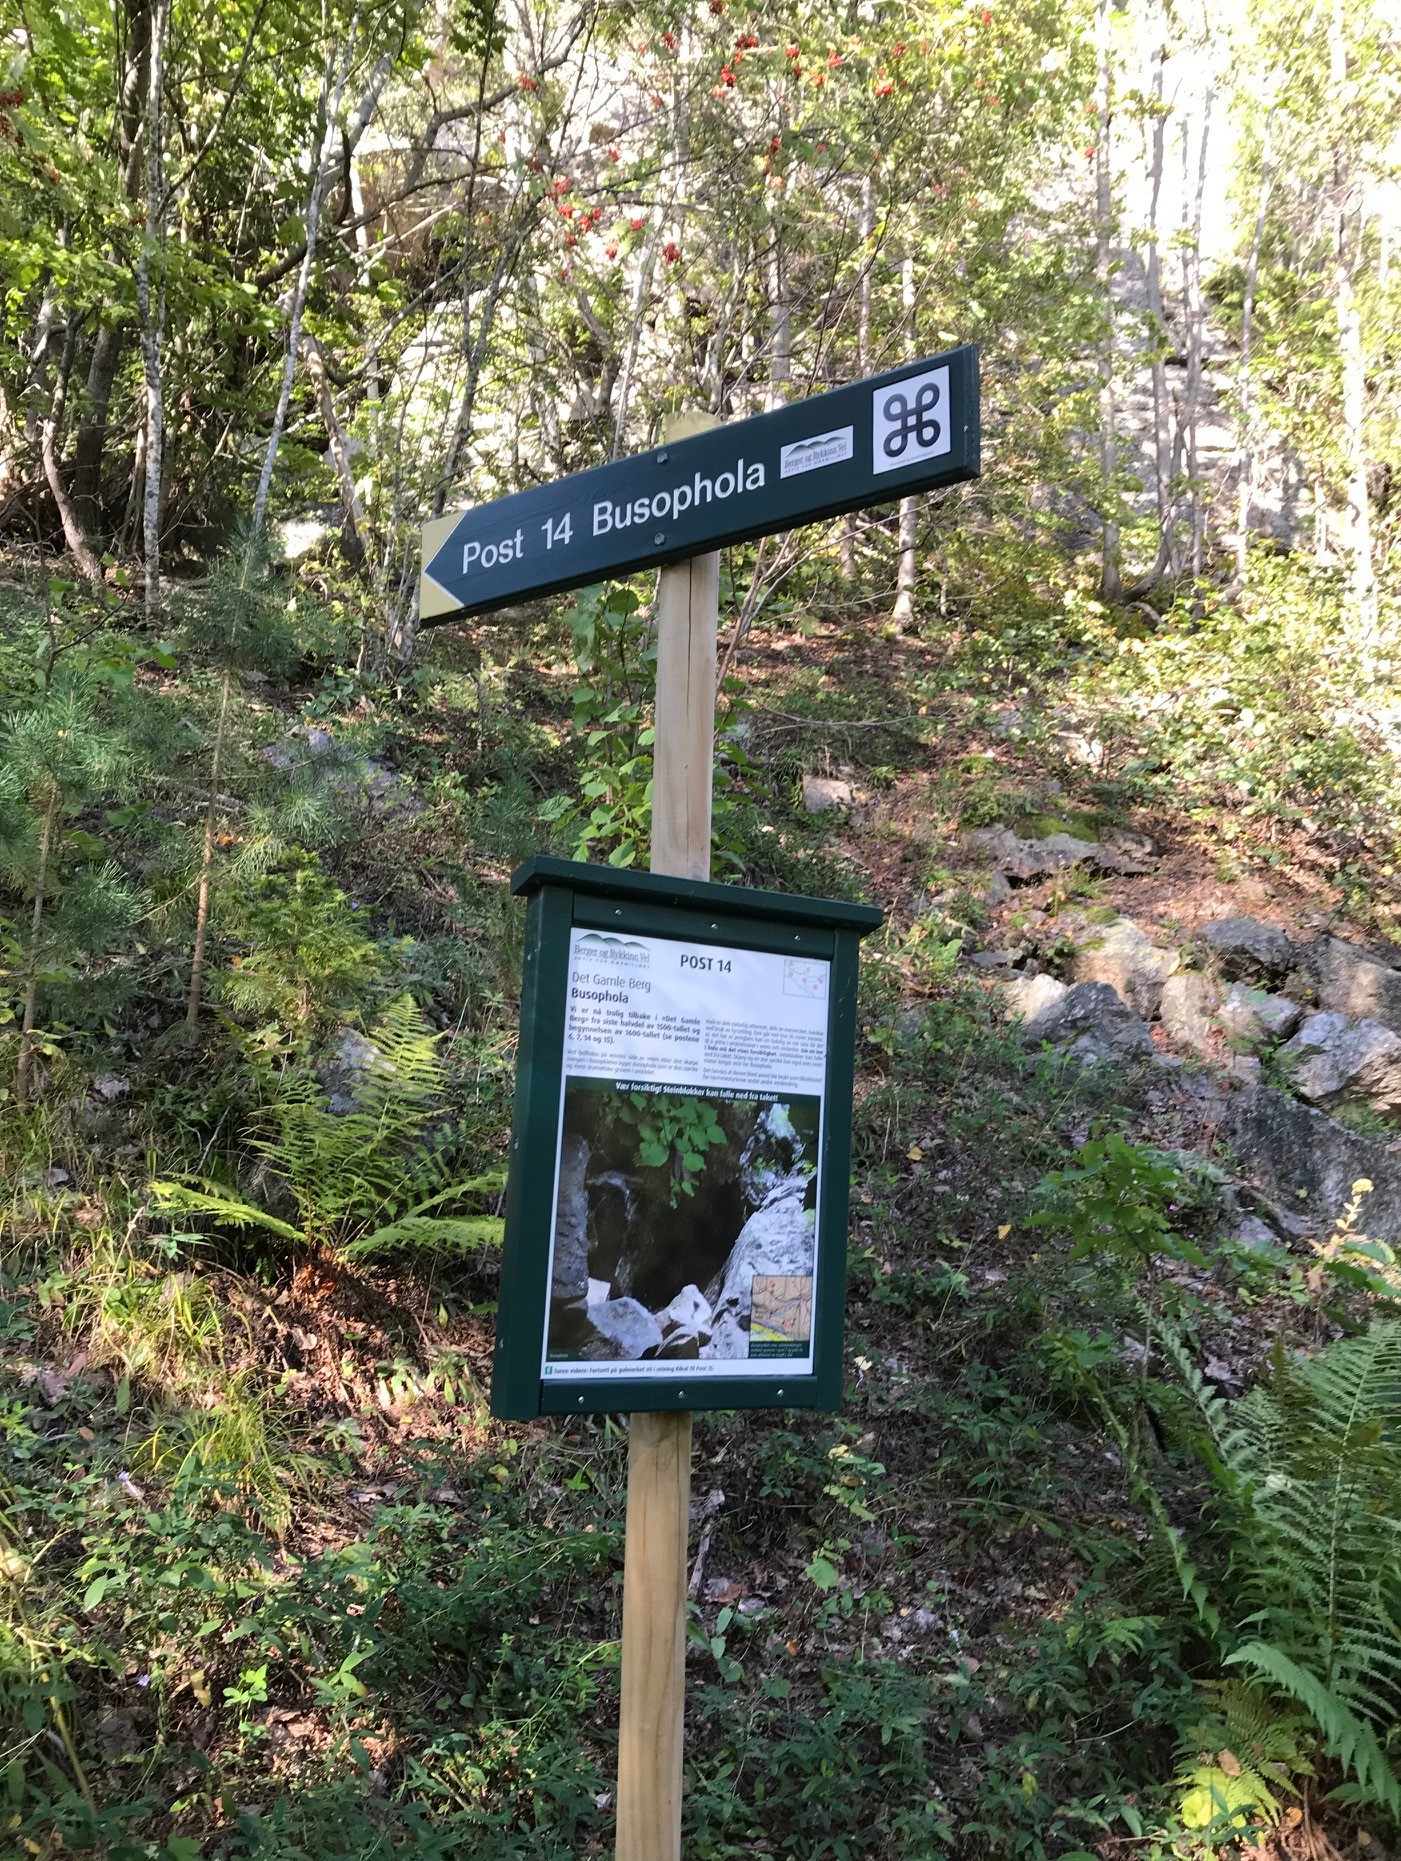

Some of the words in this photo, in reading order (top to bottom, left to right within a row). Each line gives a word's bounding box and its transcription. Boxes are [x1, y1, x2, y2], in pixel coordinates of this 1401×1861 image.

[784, 456, 804, 468] Berger
[805, 454, 812, 462] og
[812, 446, 837, 462] Rykkinn
[838, 442, 847, 454] Vel
[463, 529, 524, 574] Post
[541, 512, 573, 550] 14
[592, 458, 765, 536] Busophola
[574, 944, 598, 958] Berger
[599, 950, 609, 958] og
[610, 949, 638, 961] Rykkinn
[640, 953, 650, 962] Vel
[680, 954, 713, 970] POST
[717, 960, 732, 973] 14
[572, 972, 589, 983] Det
[593, 974, 625, 987] Gamle
[629, 978, 651, 993] Berg
[571, 987, 629, 1003] Busophola
[606, 1010, 624, 1018] trolig
[629, 1011, 650, 1020] tilbake
[681, 1017, 700, 1025] Gamle
[620, 1019, 644, 1028] halvdel
[657, 1023, 690, 1033] 1500-tallet
[569, 1023, 612, 1034] begynnelsen
[626, 1030, 660, 1038] 1600-tallet
[604, 1036, 615, 1045] 15).
[616, 1082, 630, 1090] Vær
[631, 1082, 662, 1094] forsiktig!
[663, 1085, 705, 1096] Steinblokker
[706, 1088, 718, 1097] kan
[720, 1089, 734, 1098] falle
[736, 1091, 748, 1099] ned
[749, 1092, 758, 1100] fra
[760, 1093, 778, 1101] taket!
